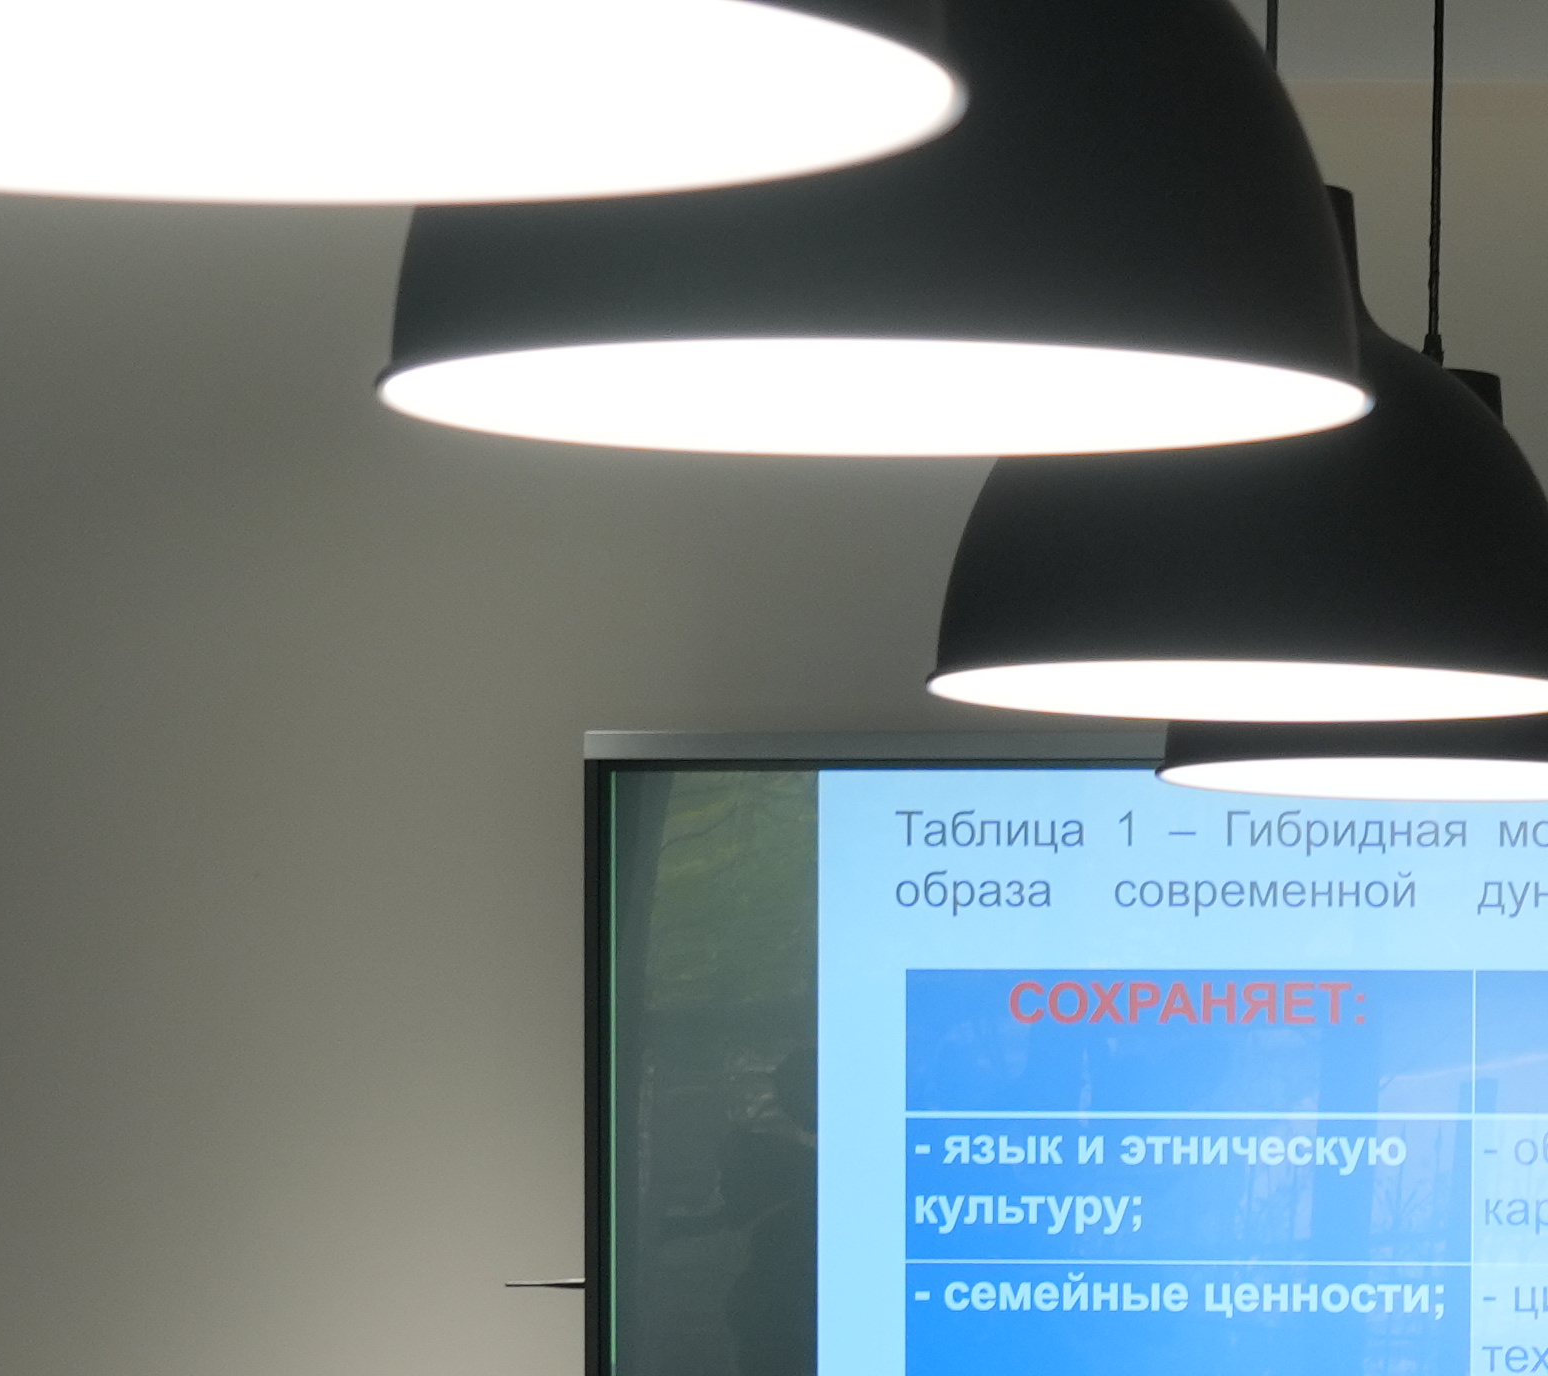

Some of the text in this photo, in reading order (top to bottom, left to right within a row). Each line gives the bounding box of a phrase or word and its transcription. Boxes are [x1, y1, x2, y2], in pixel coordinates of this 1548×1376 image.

[895, 810, 1084, 854] Таблица
[1119, 810, 1133, 847] 1
[1226, 810, 1467, 857] Гибридная
[895, 870, 1051, 917] образа
[1114, 871, 1415, 917] современной
[1009, 980, 1365, 1025] СОХРАНЯЕТ:
[943, 1134, 1063, 1165] язык
[1078, 1135, 1104, 1165] и
[1121, 1134, 1408, 1175] этническую
[915, 1195, 1142, 1235] культуру;
[944, 1271, 1189, 1312] семейные
[1205, 1283, 1445, 1321] ценности;
